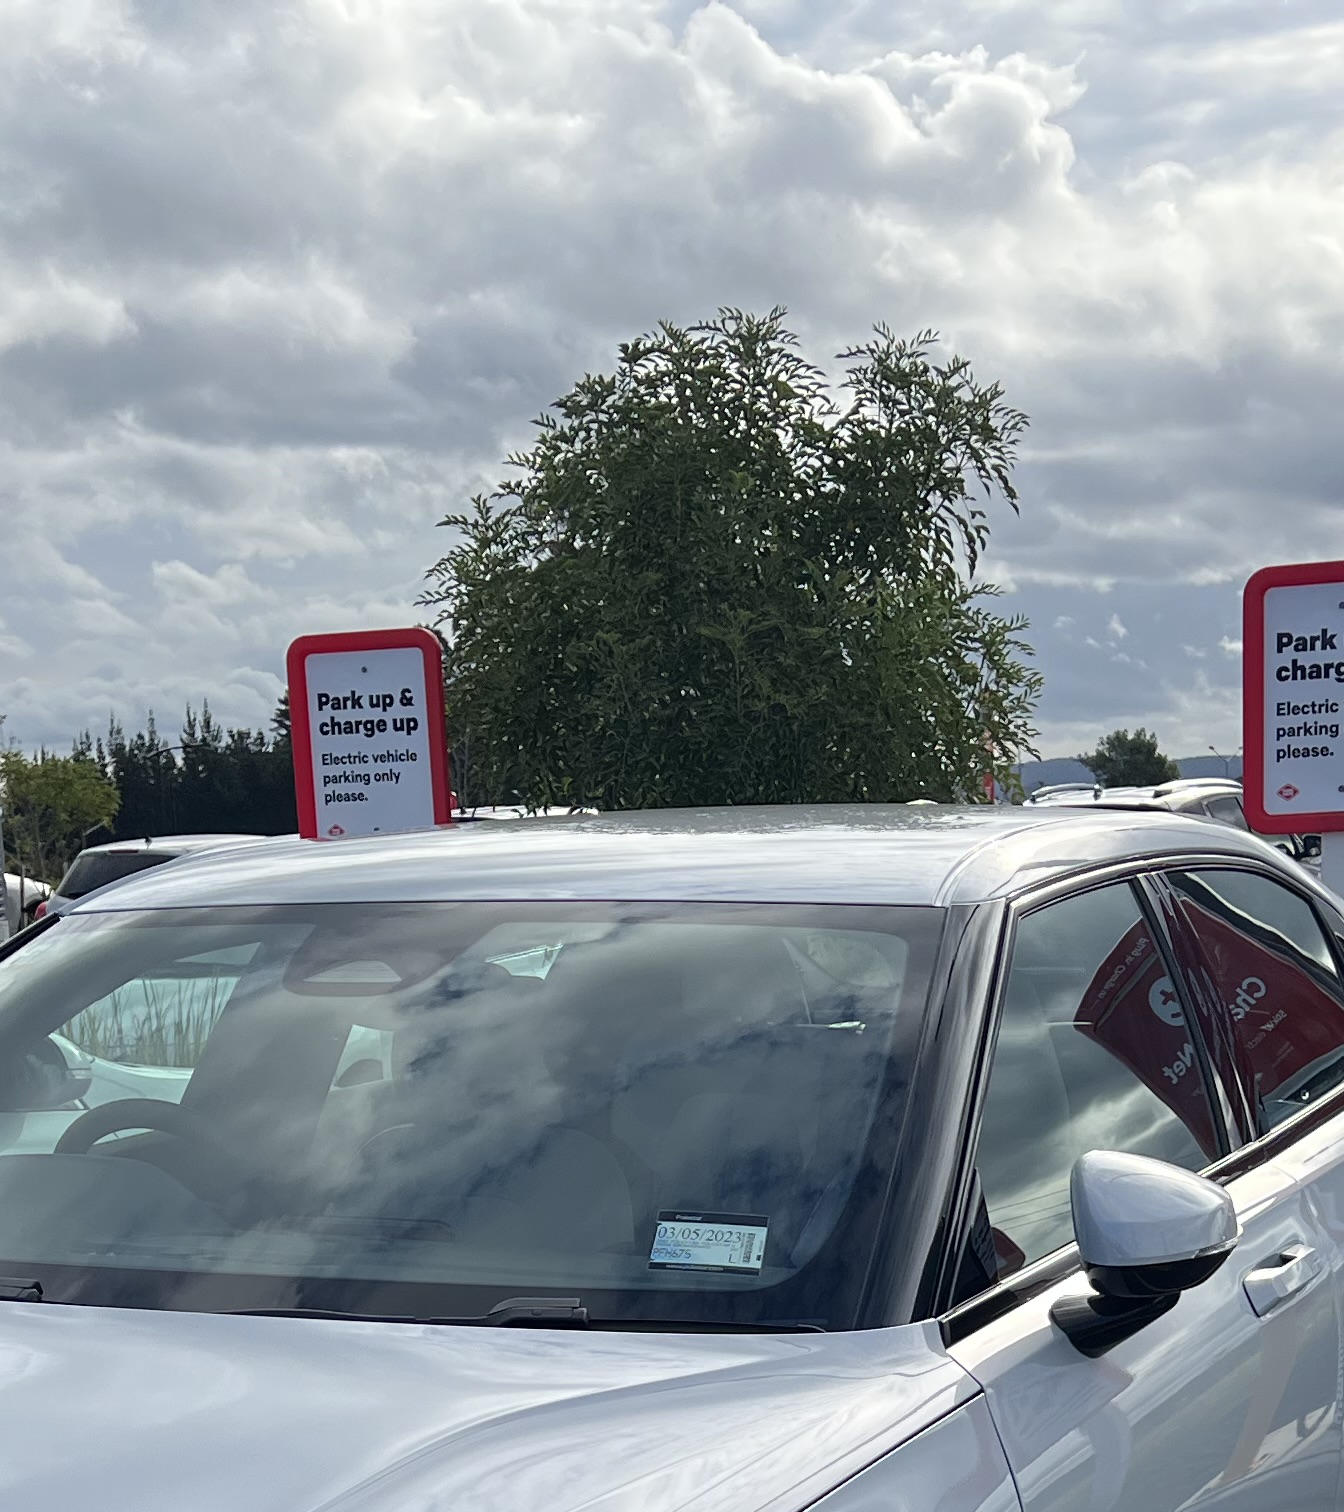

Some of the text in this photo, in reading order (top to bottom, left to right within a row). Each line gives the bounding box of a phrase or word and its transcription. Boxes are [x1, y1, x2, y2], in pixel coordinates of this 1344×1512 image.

[1276, 628, 1337, 654] Park
[317, 688, 414, 712] Park up &
[1276, 699, 1339, 716] Electric
[319, 716, 419, 738] charge up
[1276, 720, 1339, 741] parking
[322, 749, 418, 766] Electric vehicle
[1276, 743, 1334, 762] please.
[323, 769, 401, 787] parking only
[324, 790, 369, 805] please.
[658, 1226, 741, 1243] 03/05/2023
